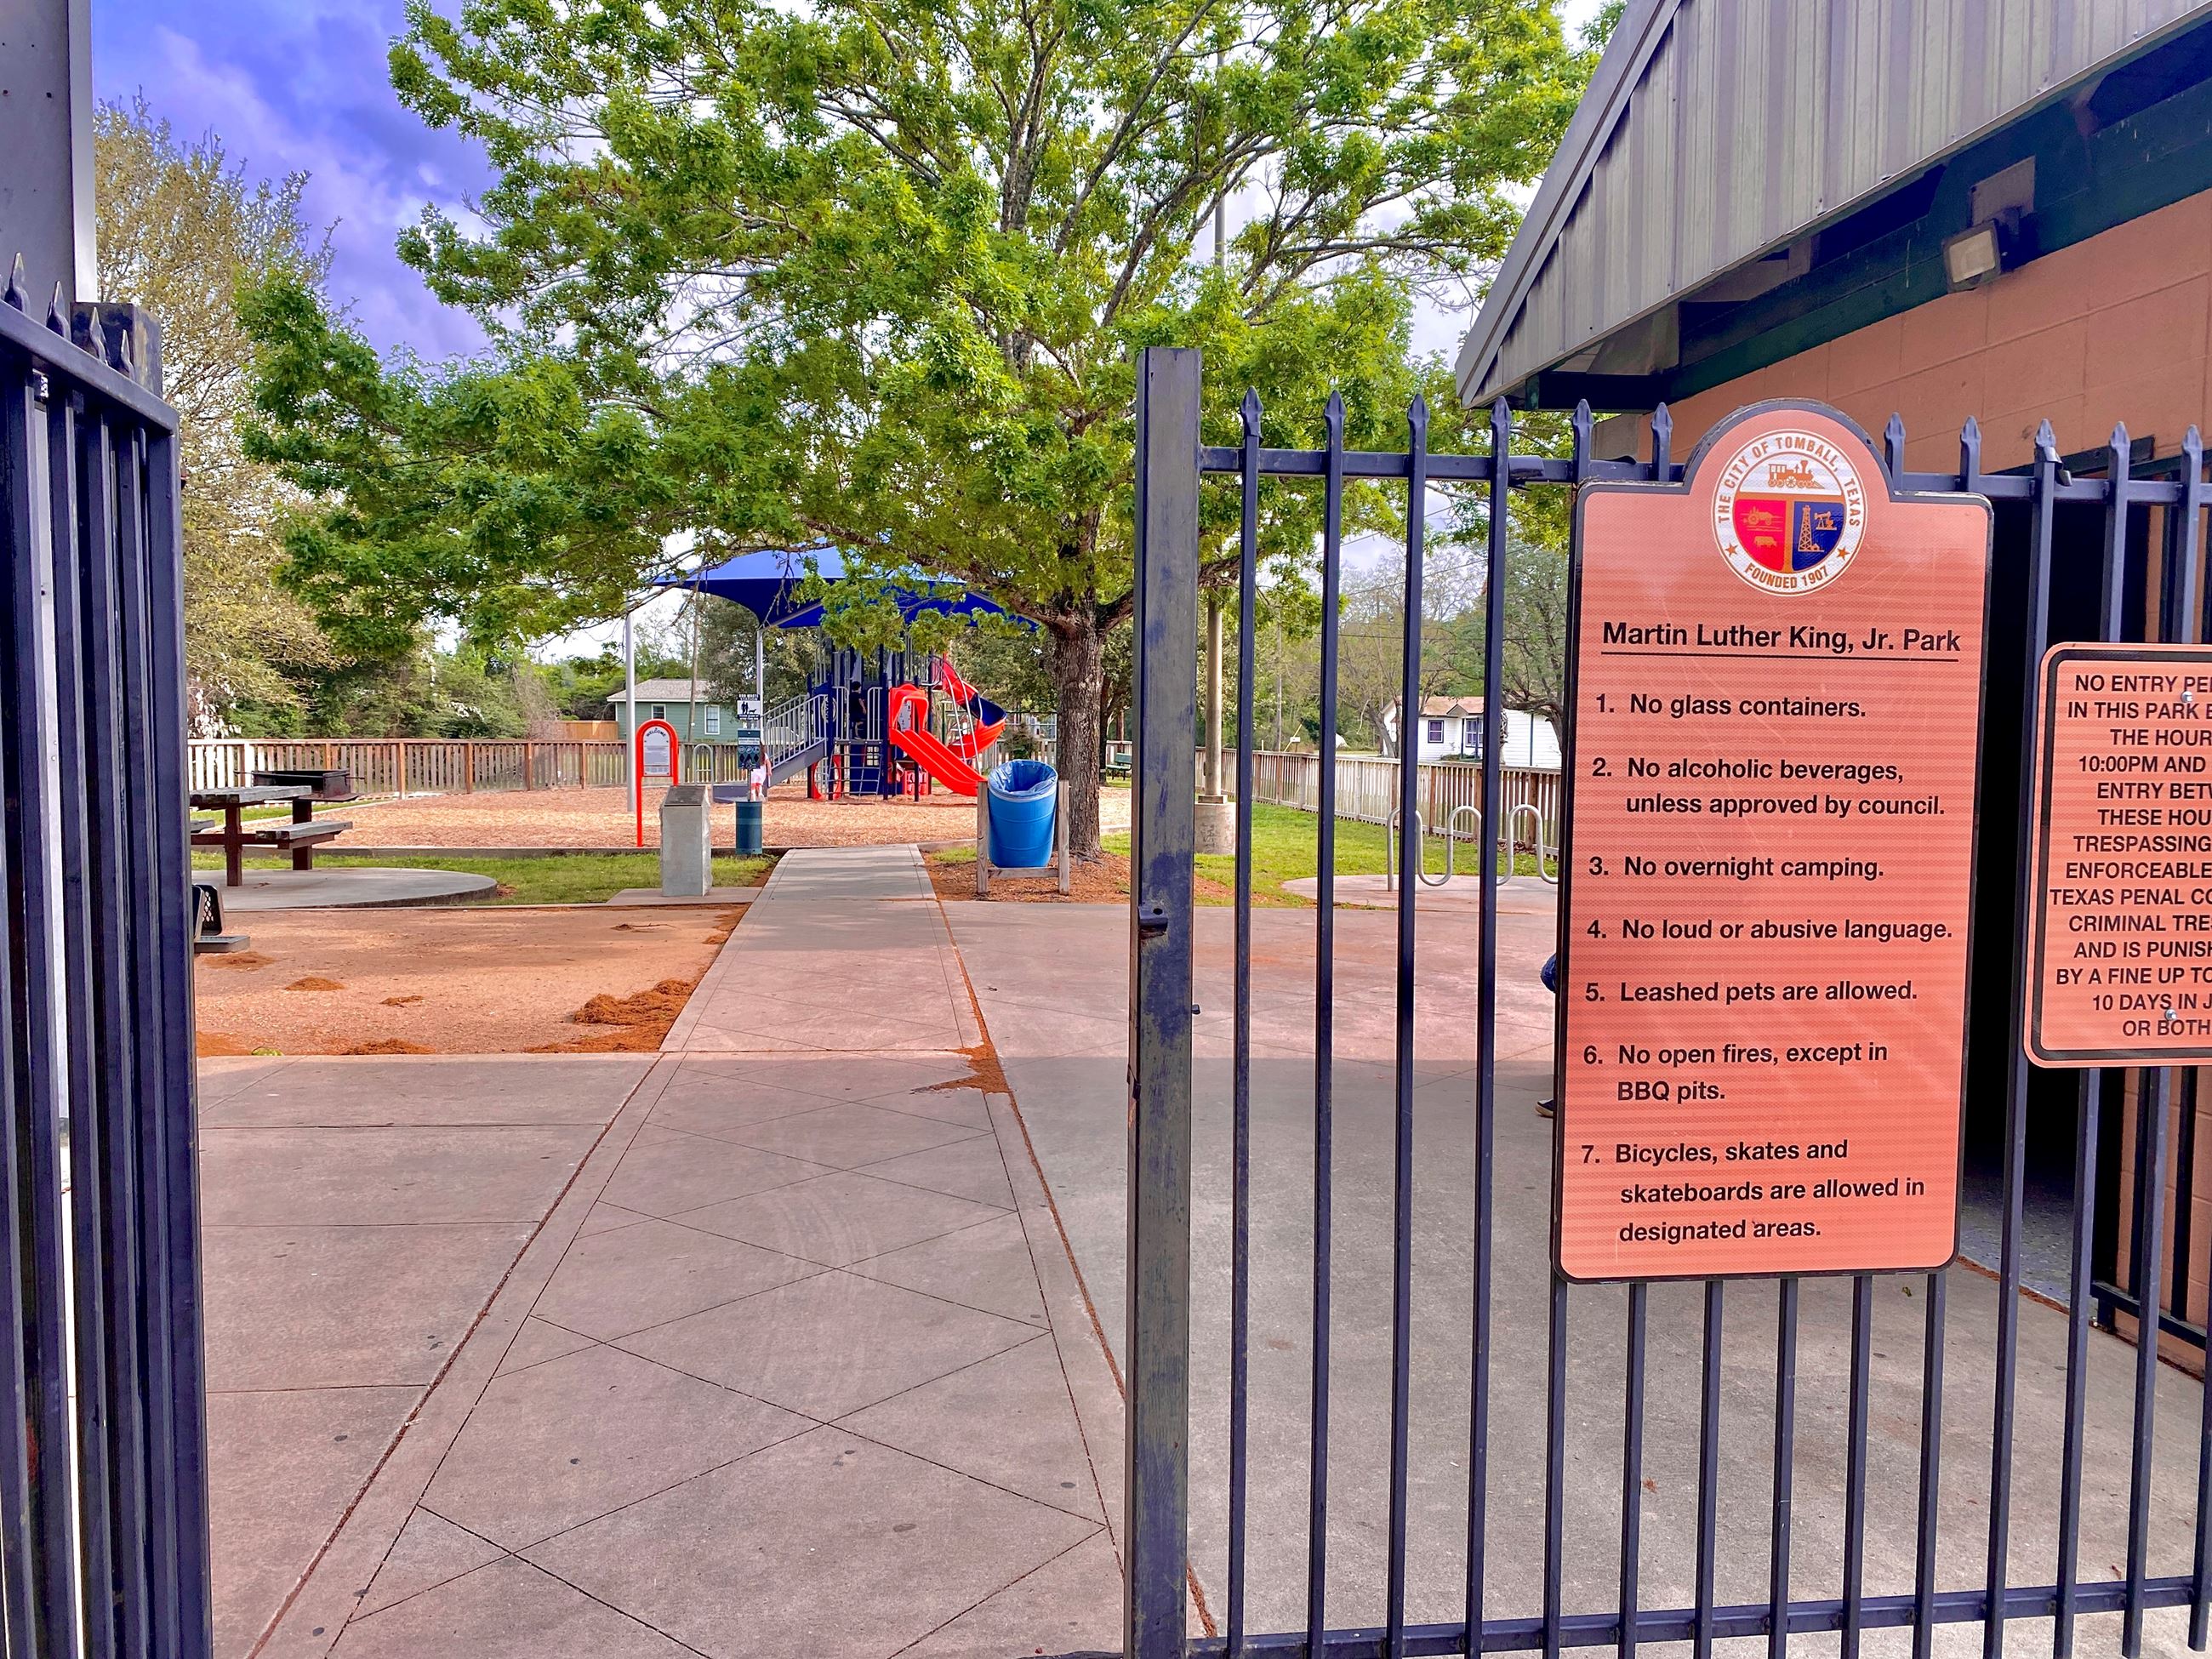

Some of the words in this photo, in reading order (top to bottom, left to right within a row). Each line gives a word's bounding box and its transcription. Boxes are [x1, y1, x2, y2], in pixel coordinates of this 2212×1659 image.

[1719, 495, 1730, 523] THE
[1725, 457, 1749, 488] CITY
[1752, 442, 1769, 459] OF
[1776, 436, 1839, 472] TOMBALL,
[1844, 478, 1861, 527] TEXAS
[1745, 562, 1798, 589] FOUNDED
[1802, 566, 1828, 586] 1907
[1604, 622, 1687, 645] Martin
[1697, 624, 1782, 647] Luther
[1790, 626, 1853, 653] King,
[1862, 628, 1893, 649] Jr.
[1904, 629, 1960, 651] Park
[2076, 676, 2104, 691] NO
[2112, 676, 2177, 692] ENTRY
[2183, 677, 2212, 693] PE
[1597, 693, 1614, 712] 1.
[1631, 694, 1662, 713] No
[1671, 695, 1731, 718] glass
[1740, 697, 1865, 716] containers.
[2068, 702, 2087, 717] IN
[2095, 702, 2138, 718] THIS
[2146, 703, 2198, 719] PARK
[2111, 729, 2148, 745] THE
[1593, 757, 1611, 776] 2.
[1628, 758, 1660, 777] No
[1668, 758, 1773, 778] alcoholic
[1781, 760, 1902, 784] beverages,
[2079, 756, 2158, 772] 10:00PM
[2164, 756, 2205, 772] AND
[2098, 783, 2164, 798] ENTRY
[2170, 784, 2212, 799] BET
[1627, 793, 1702, 812] unless
[1710, 795, 1817, 817] approved
[1826, 795, 1851, 818] by
[1859, 796, 1944, 814] council.
[2098, 809, 2162, 825] THESE
[2073, 835, 2210, 852] TRESPASSING
[1589, 857, 1608, 875] 3.
[1625, 857, 1656, 875] No
[1665, 857, 1774, 881] overnight
[1782, 858, 1883, 881] camping.
[2067, 863, 2212, 878] ENFORCEABLE
[2050, 889, 2113, 904] TEXAS
[2121, 889, 2184, 904] PENAL
[1587, 920, 1606, 938] 4.
[1623, 920, 1654, 938] No
[1663, 920, 1712, 938] loud
[1720, 924, 1743, 938] or
[1751, 920, 1837, 938] abusive
[1845, 920, 1951, 942] language.
[2069, 915, 2166, 932] CRIMINAL
[2173, 915, 2212, 931] TRE
[2074, 943, 2116, 958] AND
[2124, 942, 2140, 957] IS
[2057, 969, 2083, 984] BY
[2089, 969, 2101, 983] A
[2109, 968, 2152, 983] FINE
[2159, 968, 2184, 983] UP
[1586, 983, 1605, 1001] 5.
[1621, 982, 1718, 1001] Leashed
[1726, 983, 1775, 1005] pets
[1783, 986, 1817, 1000] are
[1826, 981, 1916, 1000] allowed.
[2094, 995, 2112, 1010] 10
[2120, 994, 2171, 1010] DAYS
[2179, 994, 2196, 1009] IN
[2124, 1021, 2150, 1035] OR
[1584, 1046, 1602, 1064] 6.
[1619, 1045, 1650, 1063] No
[1659, 1049, 1714, 1068] open
[1723, 1044, 1777, 1065] fires,
[1787, 1044, 1861, 1065] except
[1869, 1042, 1887, 1060] in
[1618, 1081, 1669, 1101] BBQ
[1678, 1081, 1725, 1104] pits.
[1582, 1145, 1599, 1163] 7.
[1616, 1143, 1717, 1166] Bicycles,
[1725, 1142, 1799, 1160] skates
[1807, 1139, 1847, 1158] and
[1621, 1182, 1762, 1203] skateboards
[1770, 1185, 1805, 1199] are
[1813, 1178, 1898, 1198] allowed
[1907, 1177, 1924, 1195] in
[1620, 1220, 1745, 1245] designated
[1753, 1223, 1820, 1237] areas.
